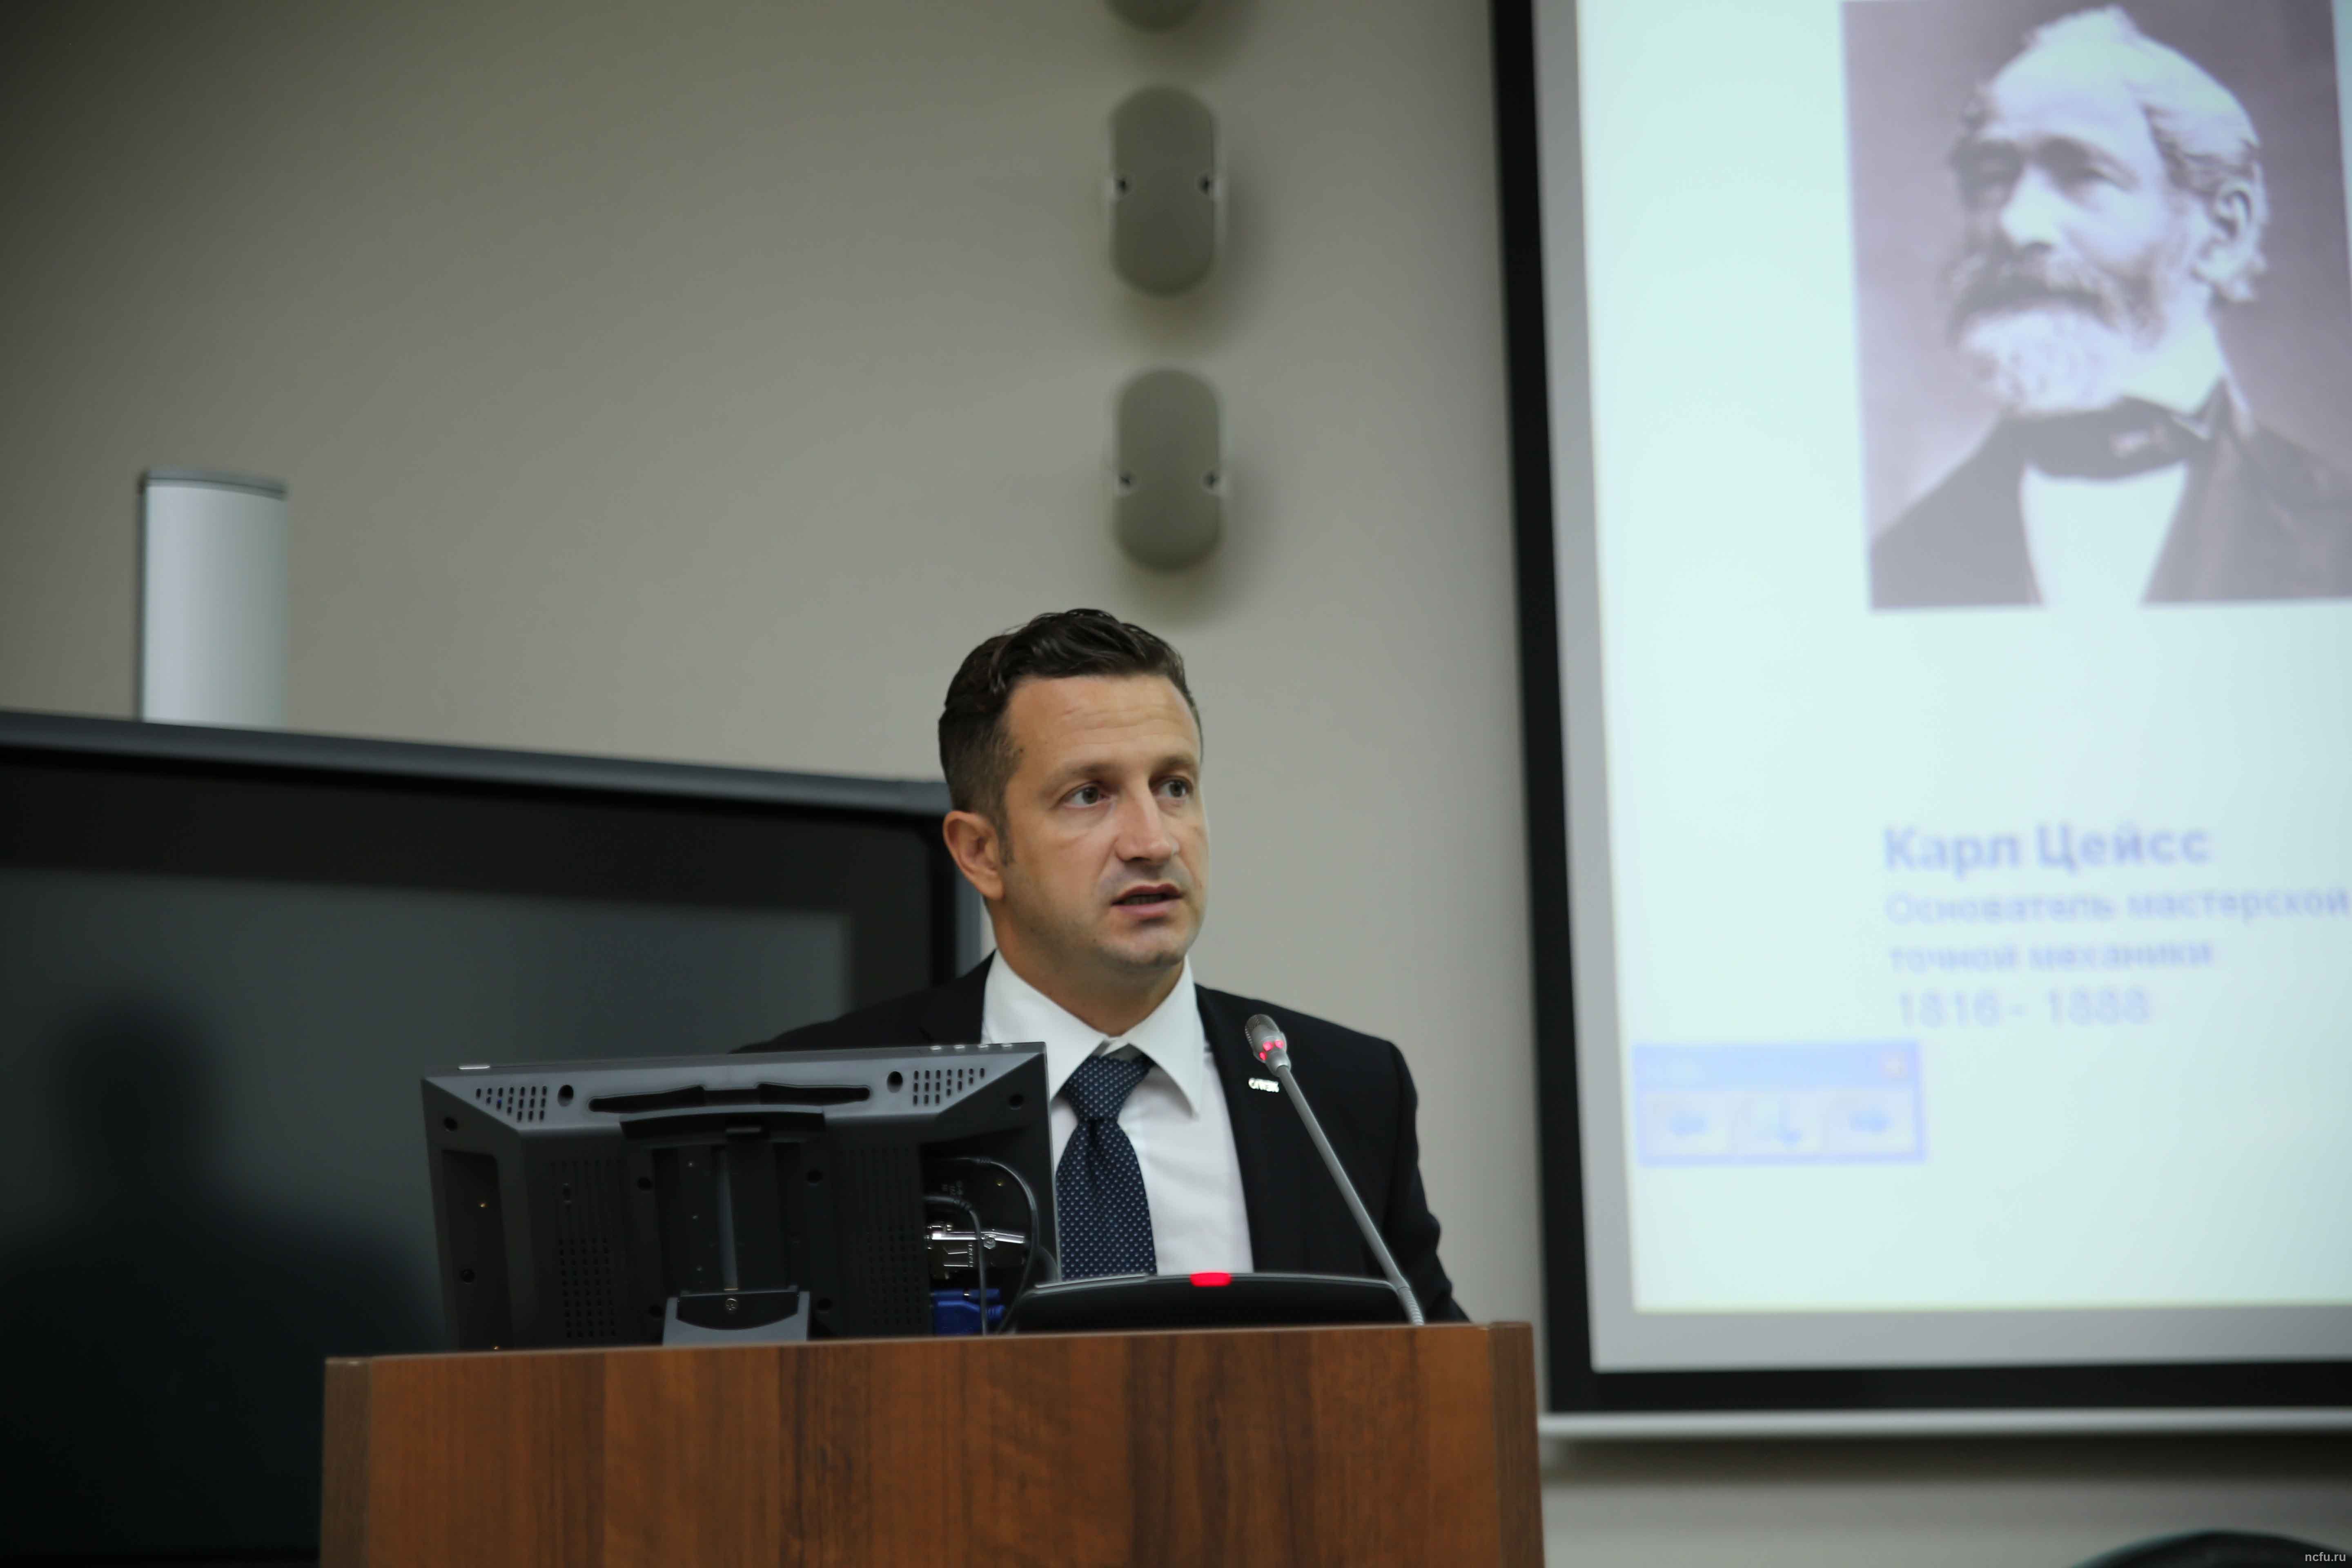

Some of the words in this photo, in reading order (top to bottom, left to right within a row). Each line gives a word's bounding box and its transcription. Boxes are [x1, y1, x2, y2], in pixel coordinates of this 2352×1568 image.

[1882, 825, 2021, 878] Карл
[2035, 822, 2211, 875] Цейсс
[1884, 891, 2114, 924] Основатель
[2127, 887, 2350, 925] мастерской
[2047, 985, 2149, 1026] 1888
